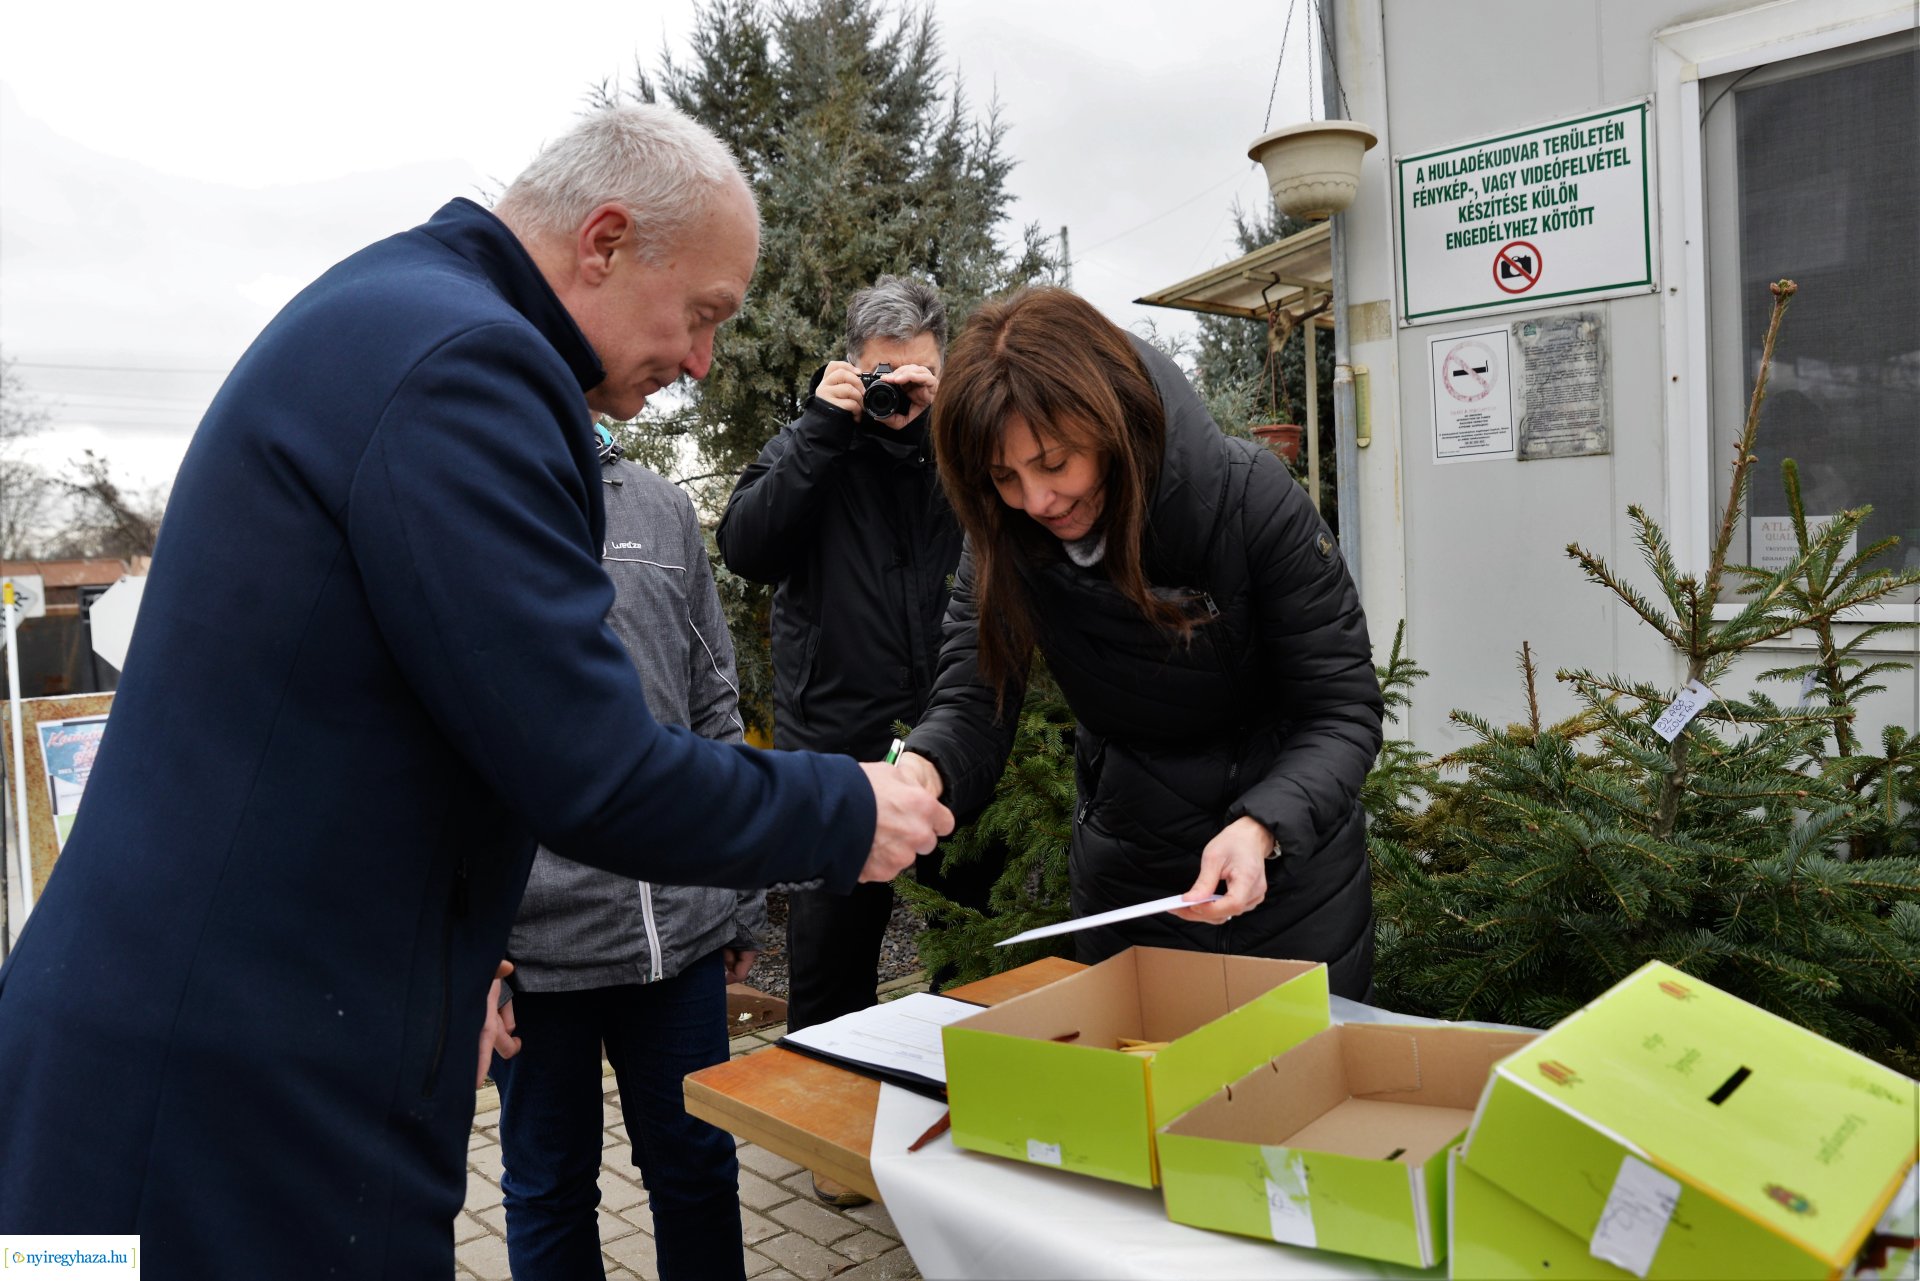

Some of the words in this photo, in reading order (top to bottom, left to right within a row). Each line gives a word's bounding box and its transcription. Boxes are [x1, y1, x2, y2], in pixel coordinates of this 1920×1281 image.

[1416, 166, 1425, 185] A
[1428, 141, 1539, 181] HULLADÉKUDVAR
[1543, 119, 1624, 156] TERÜLETÉN
[1481, 170, 1517, 195] VAGY
[1520, 147, 1631, 187] VIDEÓFELVÉTEL
[1458, 193, 1528, 223] KÉSZÍTÉSE
[1532, 181, 1578, 209] KÜLÖN
[1446, 217, 1538, 250] ENGEDÉLYHEZ
[1542, 205, 1595, 233] KÖTÖTT
